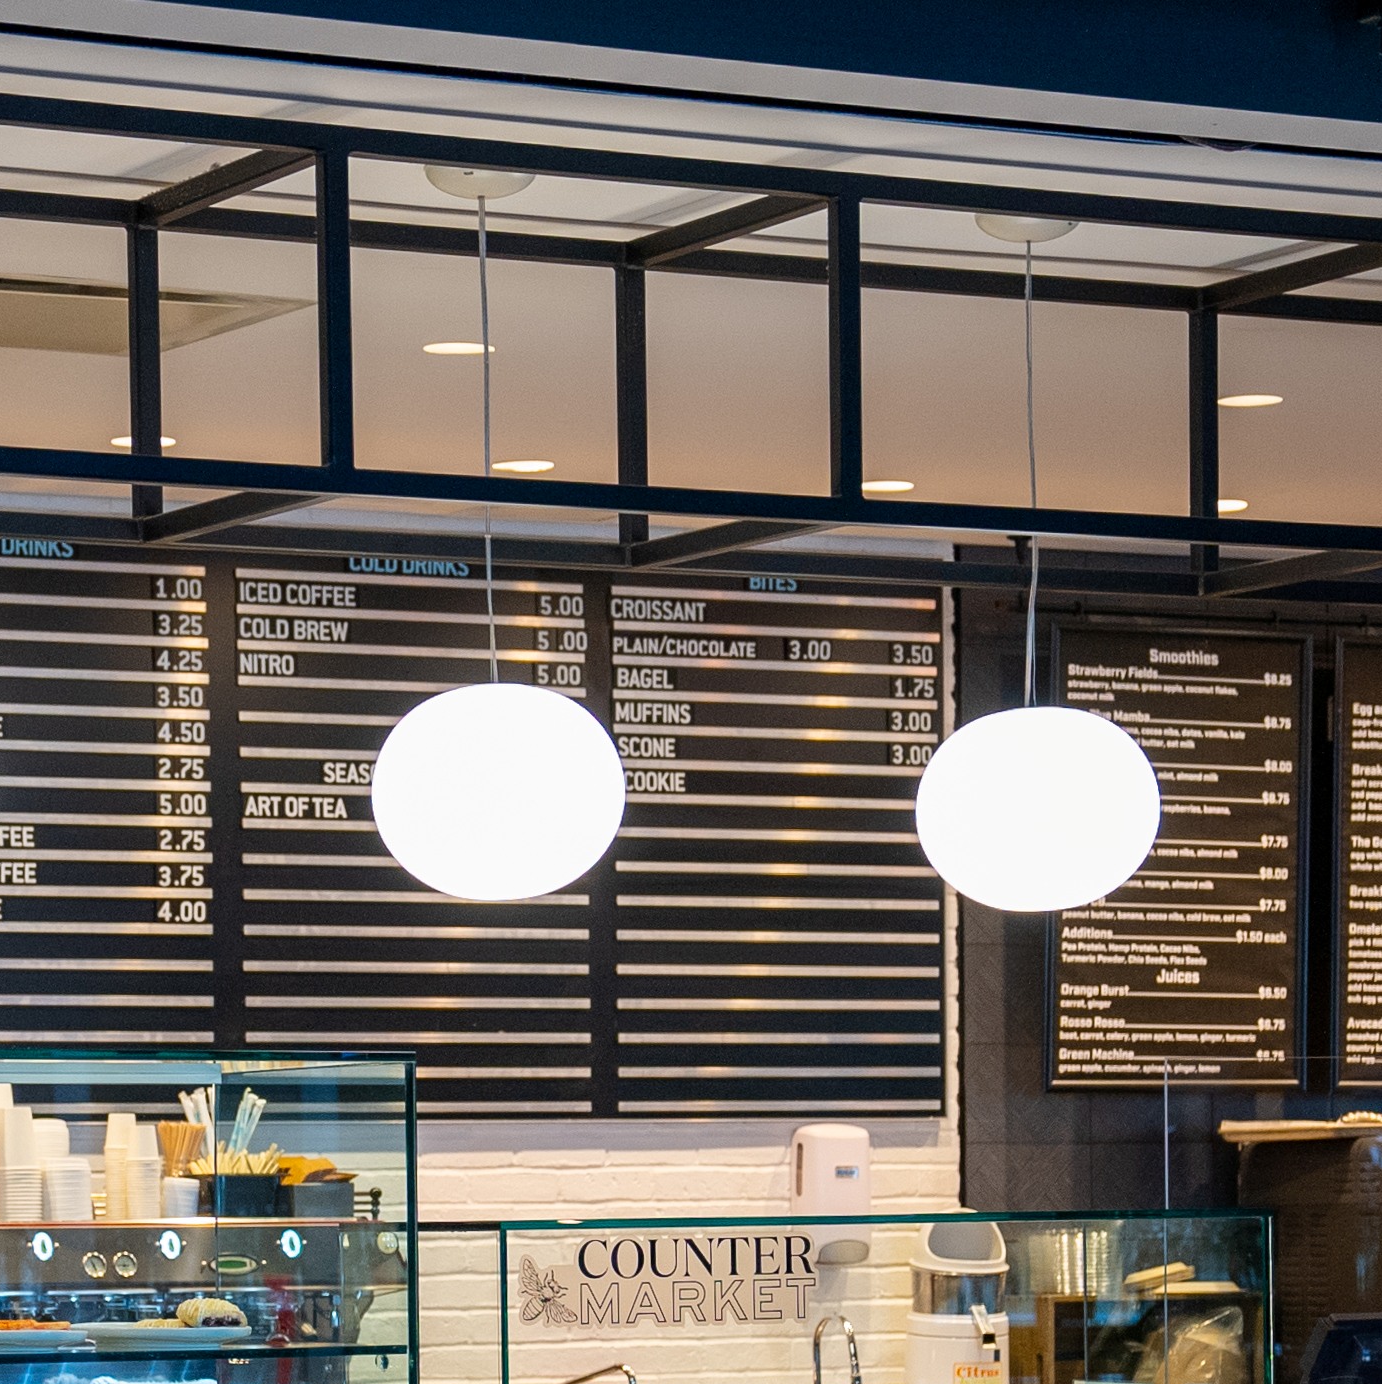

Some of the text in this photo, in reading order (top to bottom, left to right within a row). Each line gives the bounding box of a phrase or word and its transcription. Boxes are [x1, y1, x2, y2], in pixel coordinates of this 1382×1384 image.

[156, 579, 203, 600] 1.00
[749, 576, 797, 592] BITES
[240, 582, 584, 617] ICED COFFEE 5.00
[610, 599, 706, 623] CROISSANT
[158, 616, 203, 637] 3.25
[240, 618, 289, 640] COLD
[294, 620, 348, 642] BREW
[613, 636, 933, 665] PLAIN/CHOCOLATE 3.00 3.50
[1149, 649, 1219, 667] Smoothies
[157, 652, 203, 672] 4.25
[240, 654, 581, 685] NITRO 5.00
[1068, 664, 1158, 680] Strawberry Fields
[618, 668, 934, 699] BAGEL 1.75
[158, 687, 204, 708] 3.50
[615, 702, 932, 733] MUFFINS 3.00
[1114, 710, 1150, 723] Mamba
[1353, 703, 1372, 717] Egg
[158, 723, 205, 743] 4.50
[618, 737, 933, 766] SCONE 3.00
[159, 759, 204, 780] 2.75
[323, 762, 374, 784] SEAS
[624, 770, 686, 793] COOKIE
[160, 795, 207, 815] 5.00
[245, 796, 347, 818] ART OF TEA
[160, 831, 205, 851] 2.75
[159, 867, 204, 887] 3.75
[157, 902, 206, 922] 4.00
[1062, 927, 1113, 940] Additions
[1156, 968, 1200, 984] Juices
[1061, 984, 1130, 999] Orange Burst
[577, 1235, 815, 1279] COUNTER
[580, 1277, 816, 1325] MARKET
[956, 1367, 1000, 1378] Citrus
